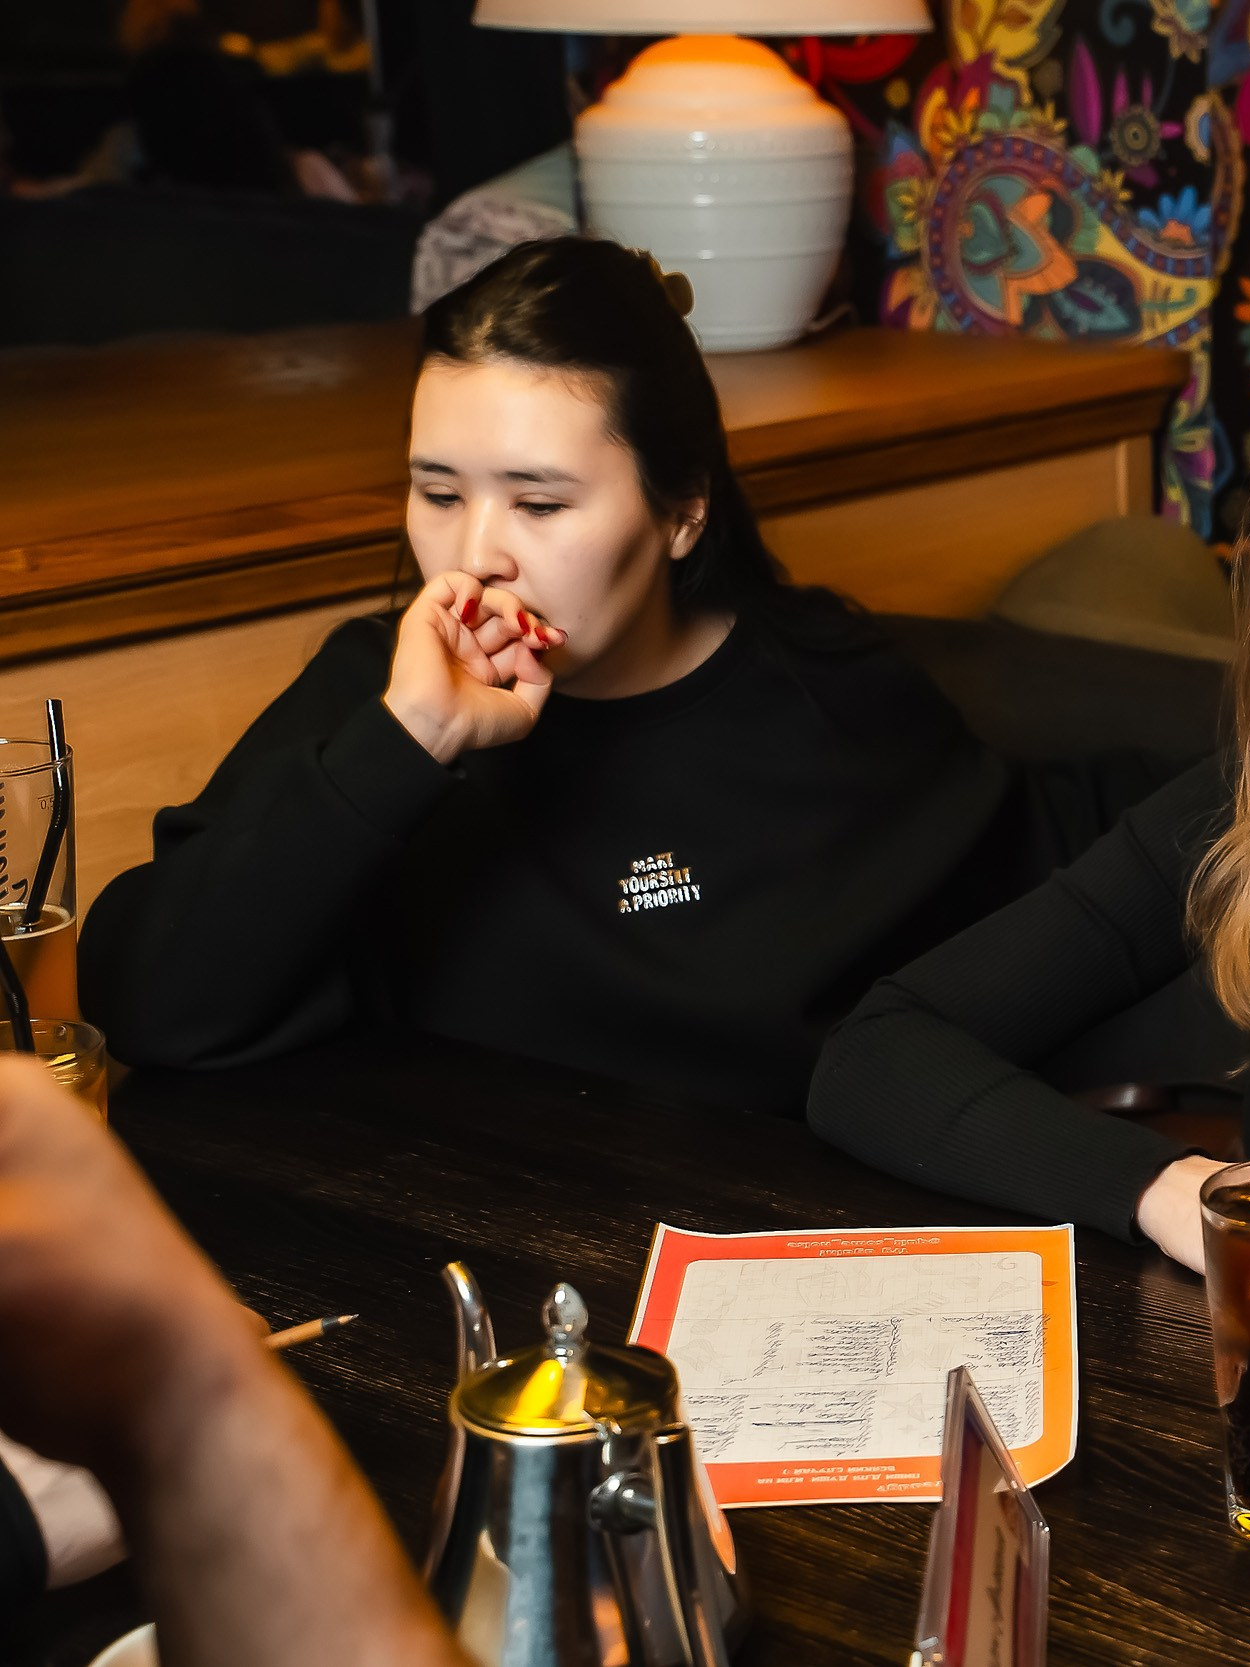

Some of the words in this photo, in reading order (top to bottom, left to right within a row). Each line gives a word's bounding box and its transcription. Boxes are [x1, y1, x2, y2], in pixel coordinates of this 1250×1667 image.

[618, 867, 691, 895] YOURSELF
[618, 898, 632, 914] A
[632, 885, 701, 911] PRIORITY
